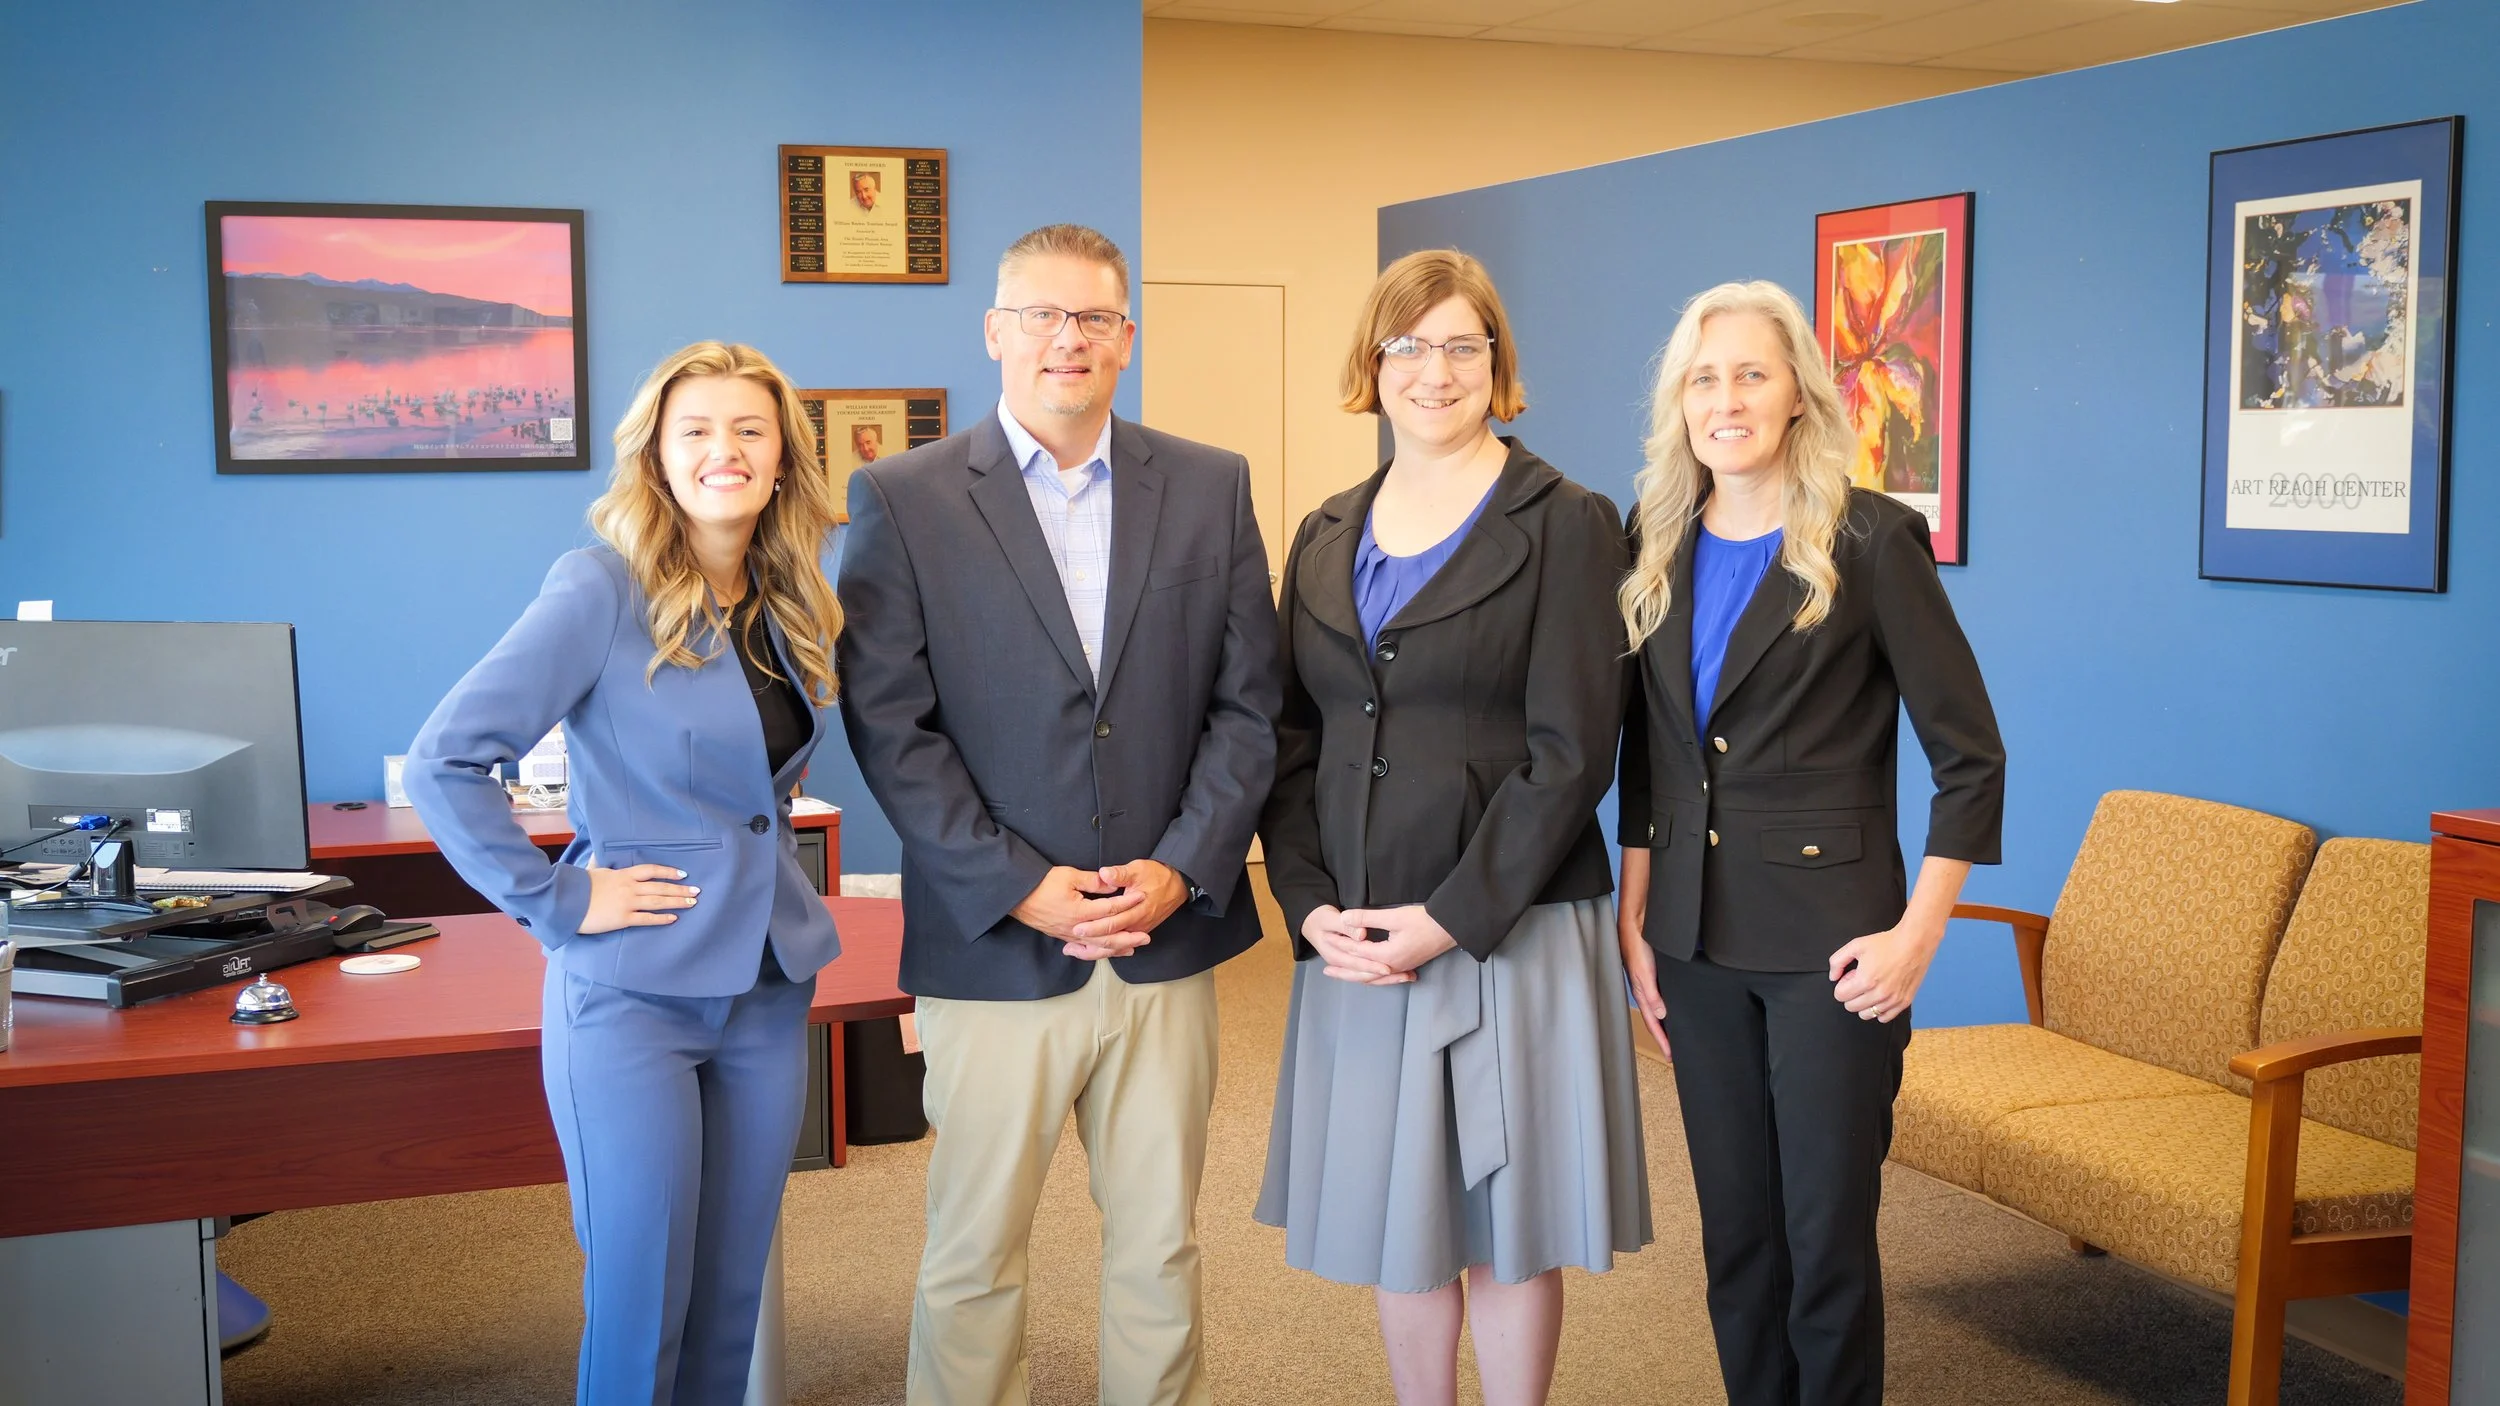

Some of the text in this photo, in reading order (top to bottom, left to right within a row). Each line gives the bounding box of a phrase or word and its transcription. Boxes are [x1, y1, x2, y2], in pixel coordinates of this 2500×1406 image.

[2231, 479, 2407, 498] ART REACH CENTER
[2268, 472, 2363, 510] 2000
